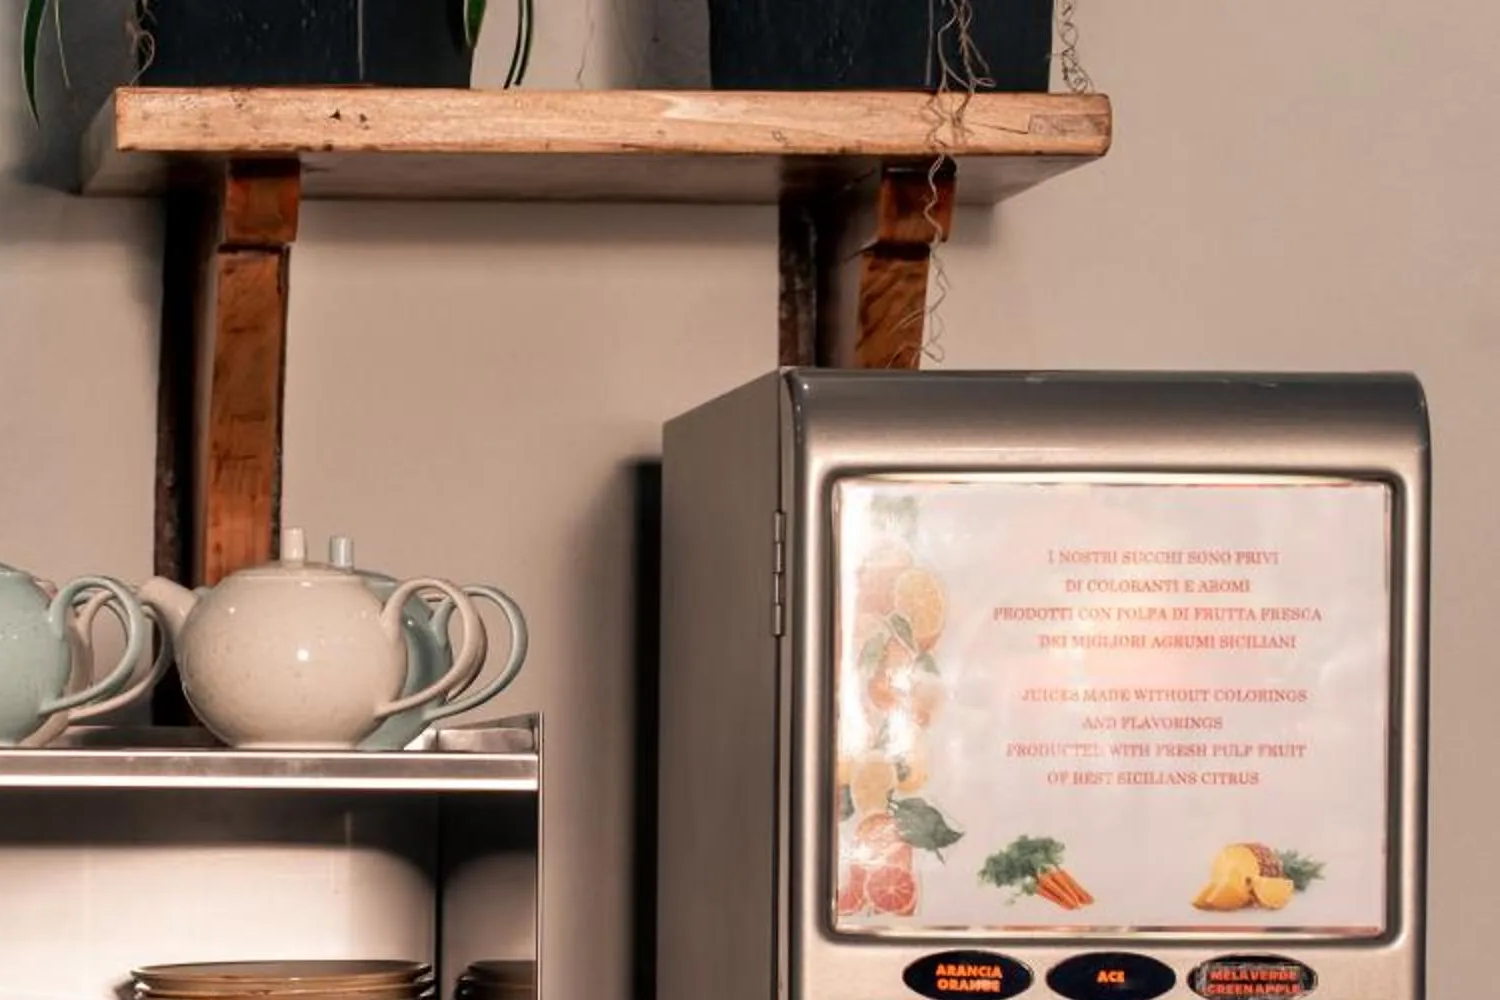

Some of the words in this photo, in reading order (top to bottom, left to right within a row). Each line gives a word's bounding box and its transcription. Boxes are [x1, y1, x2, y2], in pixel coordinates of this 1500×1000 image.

[1048, 550, 1054, 565] I
[1059, 551, 1118, 565] NOSTRI
[1121, 551, 1183, 565] SUCCHI
[1187, 551, 1231, 565] SONO
[1236, 551, 1280, 565] PRIVI
[1065, 579, 1083, 593] DI
[1086, 579, 1179, 593] COLORANTI
[1184, 579, 1195, 593] E
[1198, 579, 1251, 593] AROMI
[993, 607, 1073, 621] PRODOTTI
[1077, 607, 1111, 621] CON
[1116, 607, 1167, 621] POLPA
[1172, 607, 1190, 621] DI
[1194, 607, 1256, 621] FRUTTA
[1260, 607, 1322, 621] FRESCA
[1039, 634, 1067, 649] DEI
[1071, 635, 1146, 649] MIGLIORI
[1151, 635, 1215, 649] AGRUMI
[1219, 635, 1297, 649] SICILIANI
[1021, 688, 1080, 702] JUICES
[1082, 688, 1130, 702] MADE
[1133, 688, 1209, 702] WITHOUT
[1214, 688, 1308, 702] COLORINGS
[1081, 716, 1117, 730] AND
[1121, 716, 1223, 730] FLAVORINGS
[1108, 743, 1150, 757] WITH
[1155, 743, 1207, 757] FRESH
[1212, 743, 1253, 757] PULP
[1257, 743, 1308, 757] FRUIT
[1047, 771, 1069, 785] OF
[1072, 771, 1114, 785] BEST
[1116, 771, 1198, 785] SICILIANS
[1200, 771, 1260, 785] CITRUS
[935, 964, 1003, 979] ARANCIA
[1096, 970, 1125, 983] ACE
[936, 978, 1001, 993] ORANGE
